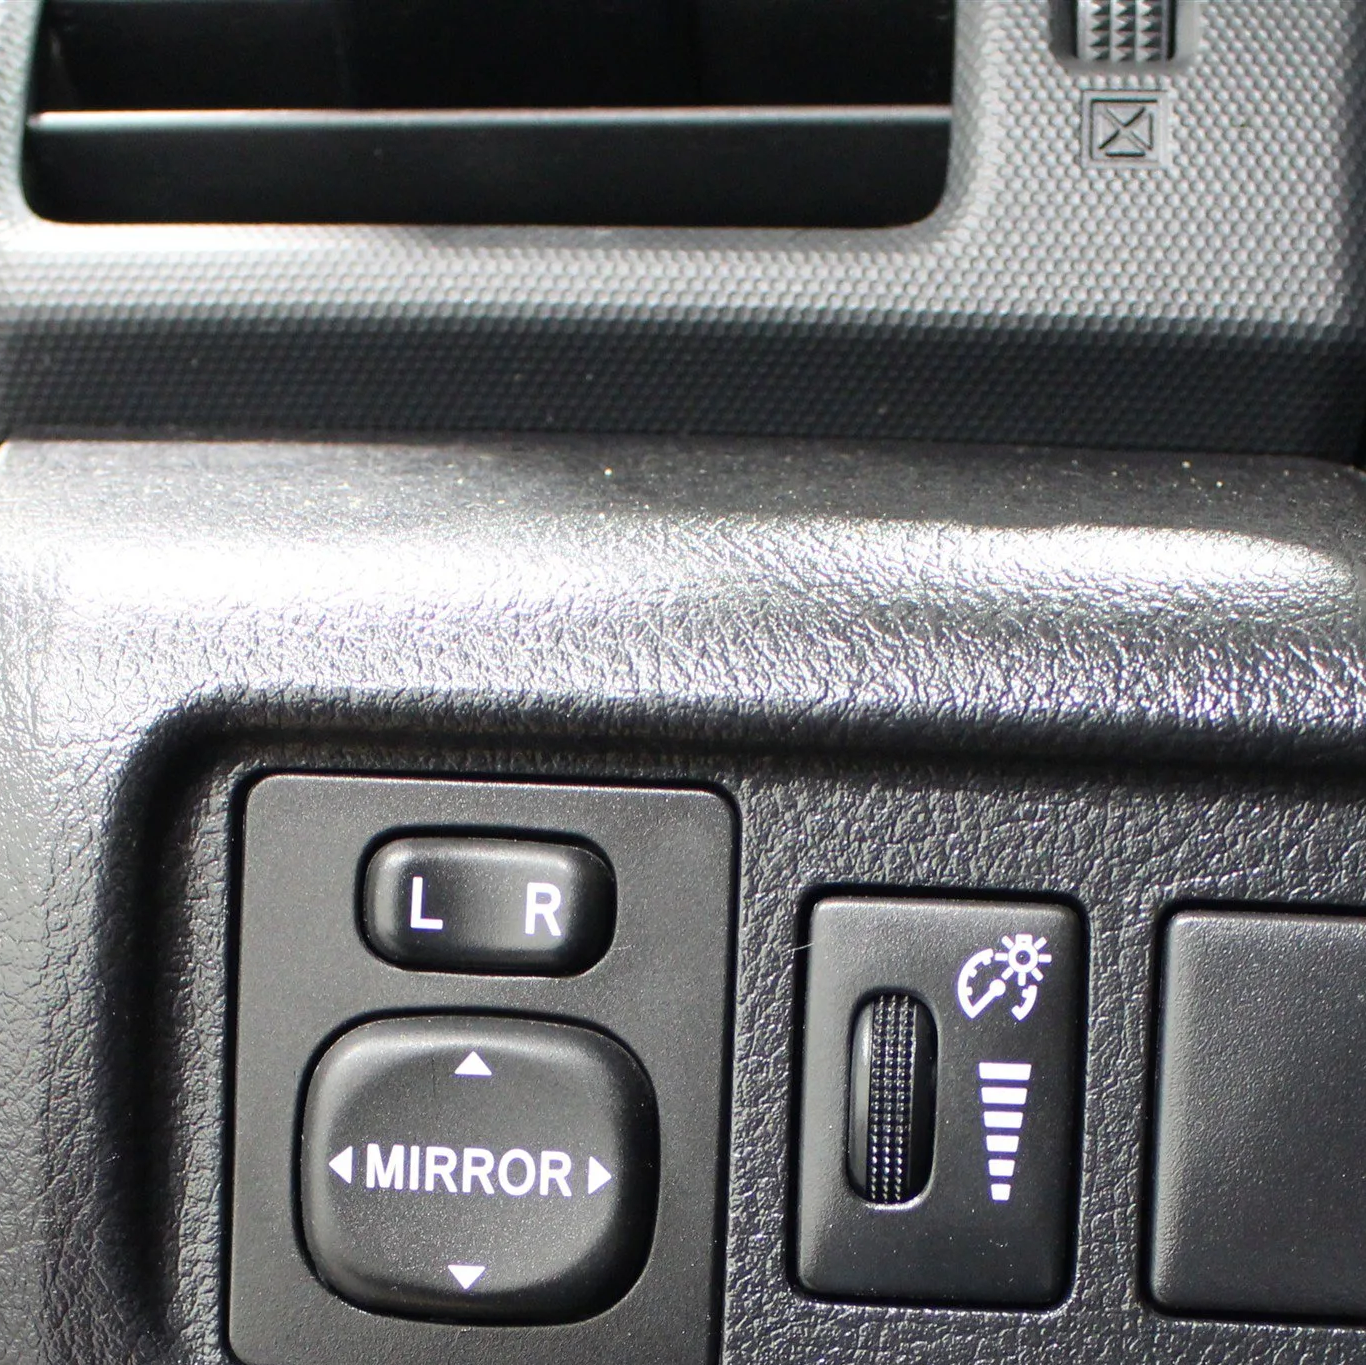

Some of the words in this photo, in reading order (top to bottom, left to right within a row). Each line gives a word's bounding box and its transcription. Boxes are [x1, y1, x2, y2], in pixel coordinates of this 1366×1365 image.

[410, 876, 443, 930] L
[524, 881, 562, 937] R
[366, 1144, 573, 1197] MIRROR
